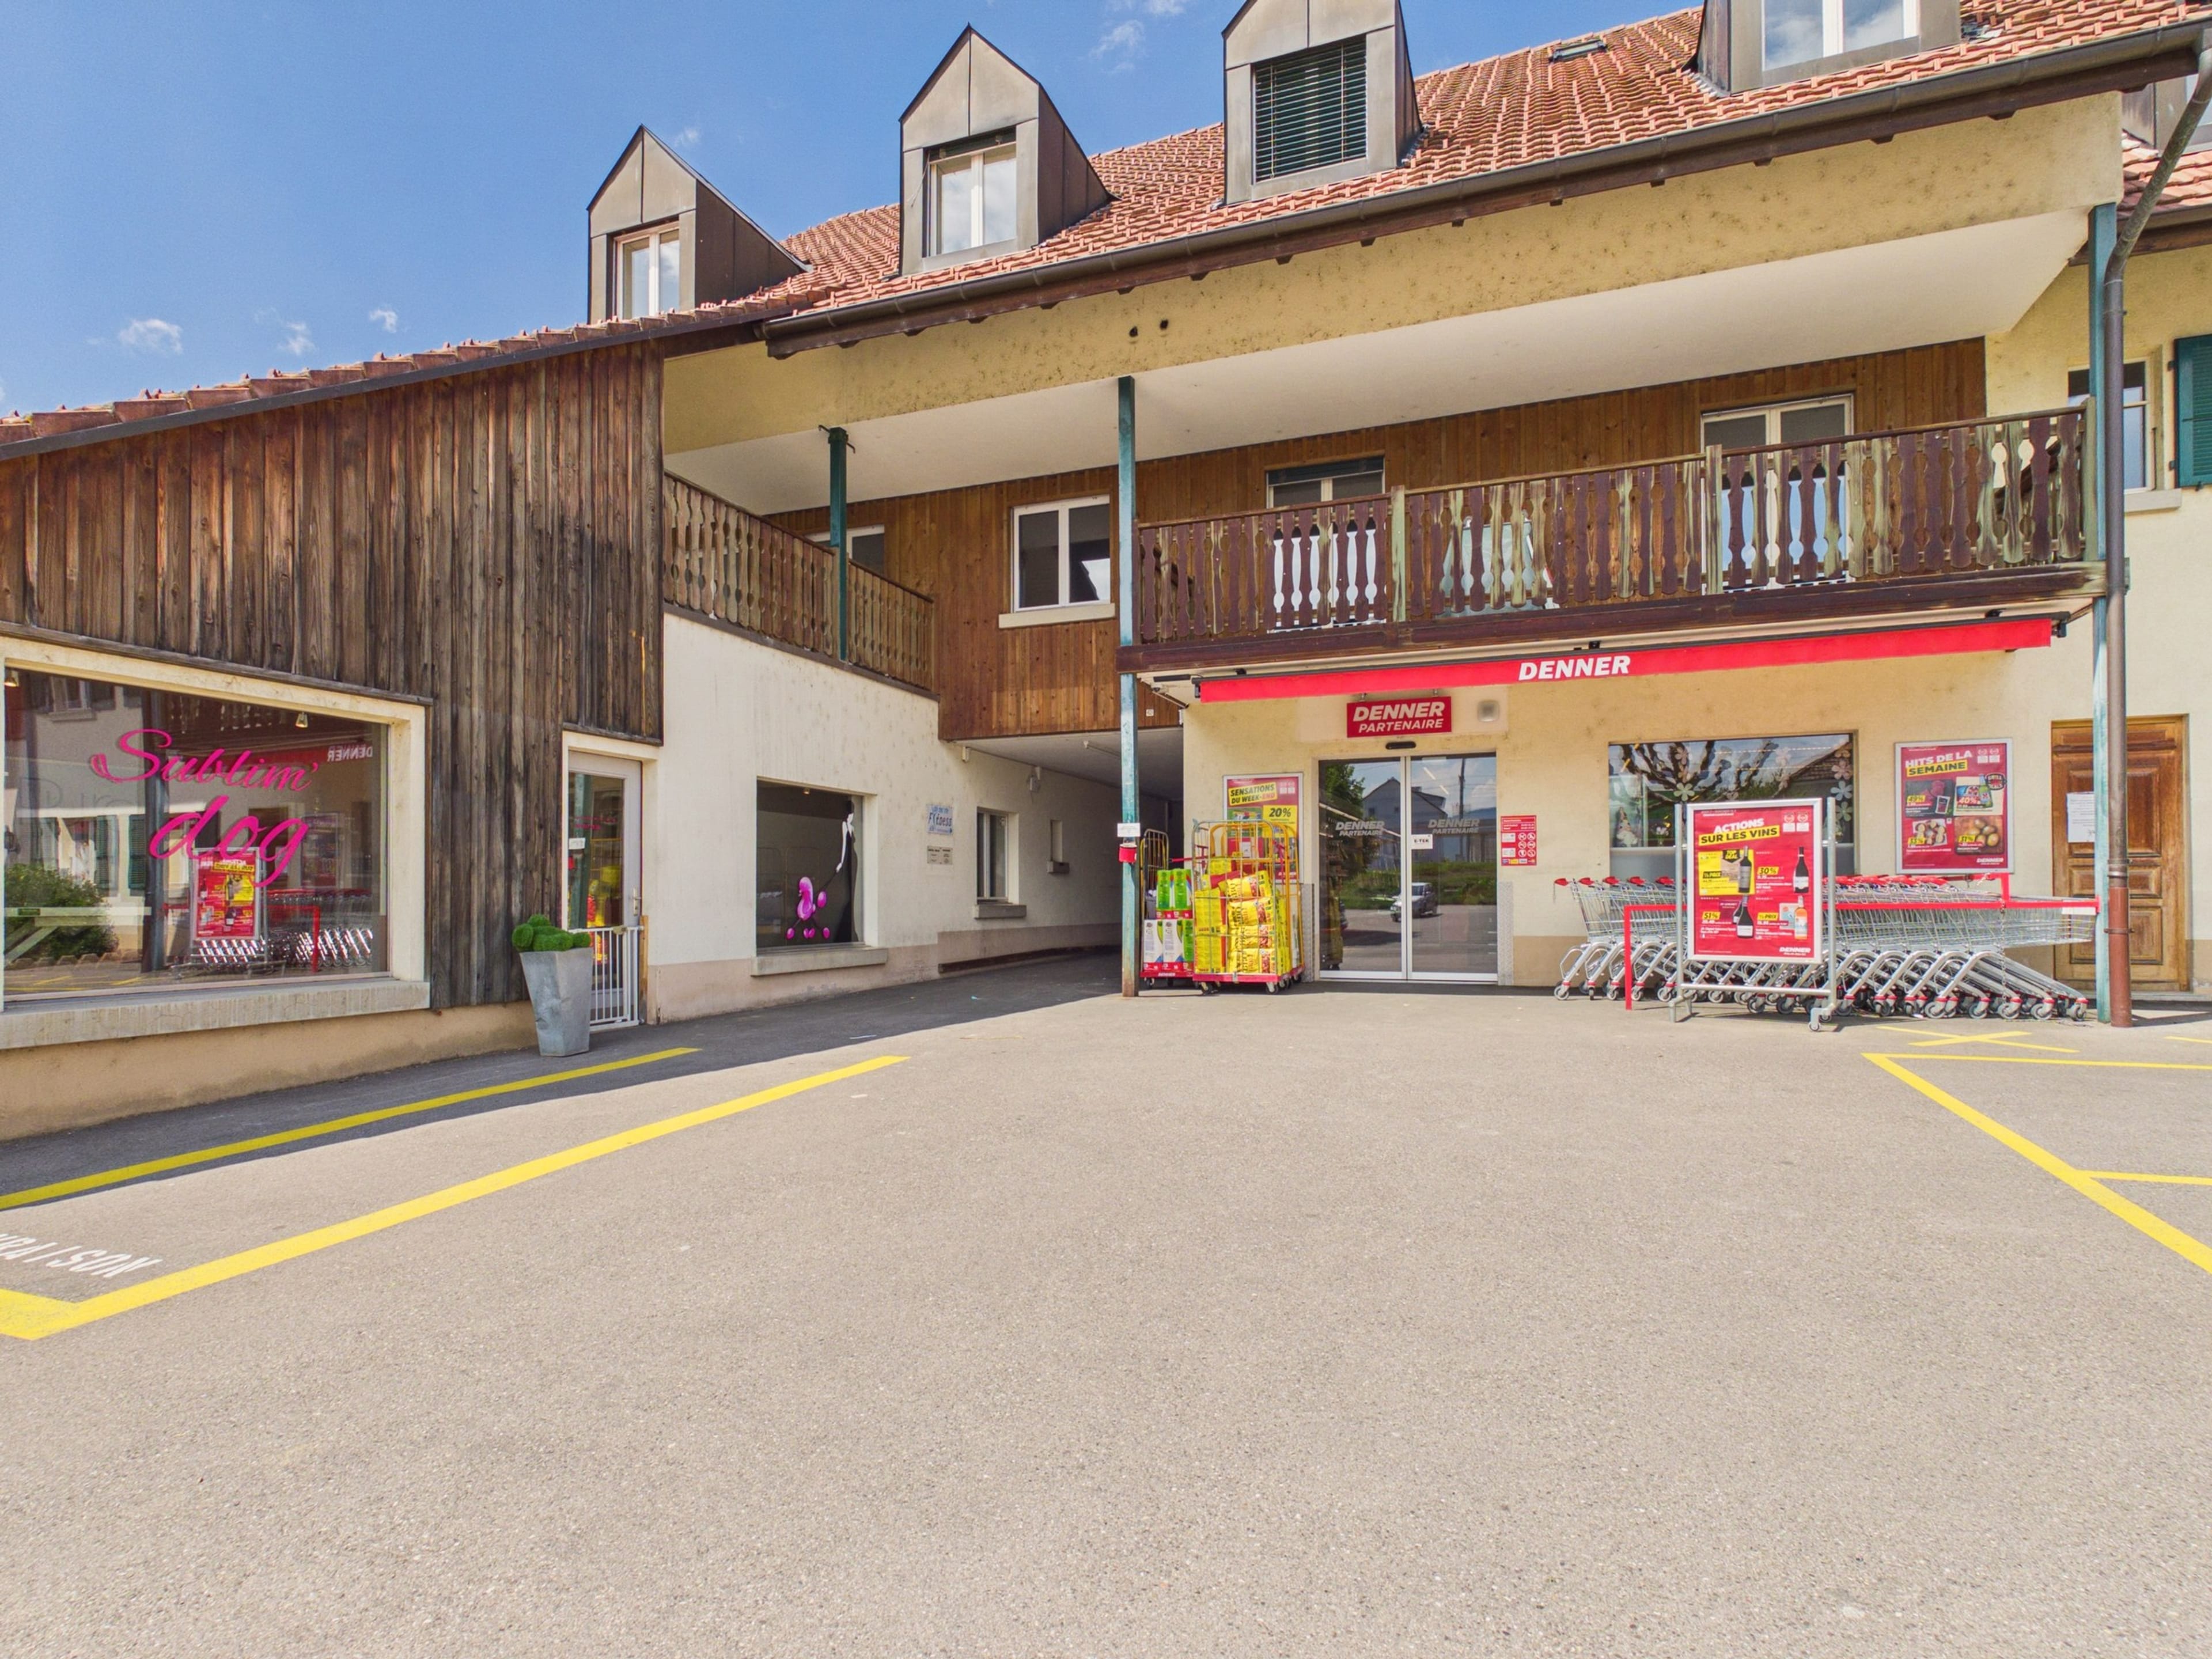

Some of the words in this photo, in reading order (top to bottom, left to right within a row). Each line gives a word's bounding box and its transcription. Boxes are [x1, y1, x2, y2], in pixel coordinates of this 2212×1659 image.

[1518, 656, 1631, 681] DENNER
[1353, 702, 1445, 722] DENNER
[1358, 718, 1444, 733] PARTENAIRE
[1905, 756, 1934, 768] HITS
[1936, 753, 1954, 763] DE
[1955, 750, 1973, 760] LA
[1908, 762, 1966, 775] SEMAINE
[1230, 784, 1275, 797] SENSATIONS
[1241, 793, 1275, 802] WEEK-END
[1269, 807, 1291, 817] 20%
[1335, 820, 1385, 831] DENNER
[1428, 818, 1480, 828] DENNER
[1714, 817, 1764, 834] ACTIONS
[149, 795, 309, 888] dog
[1700, 834, 1724, 844] SUR
[1726, 831, 1747, 841] LES
[1749, 827, 1778, 838] VINS
